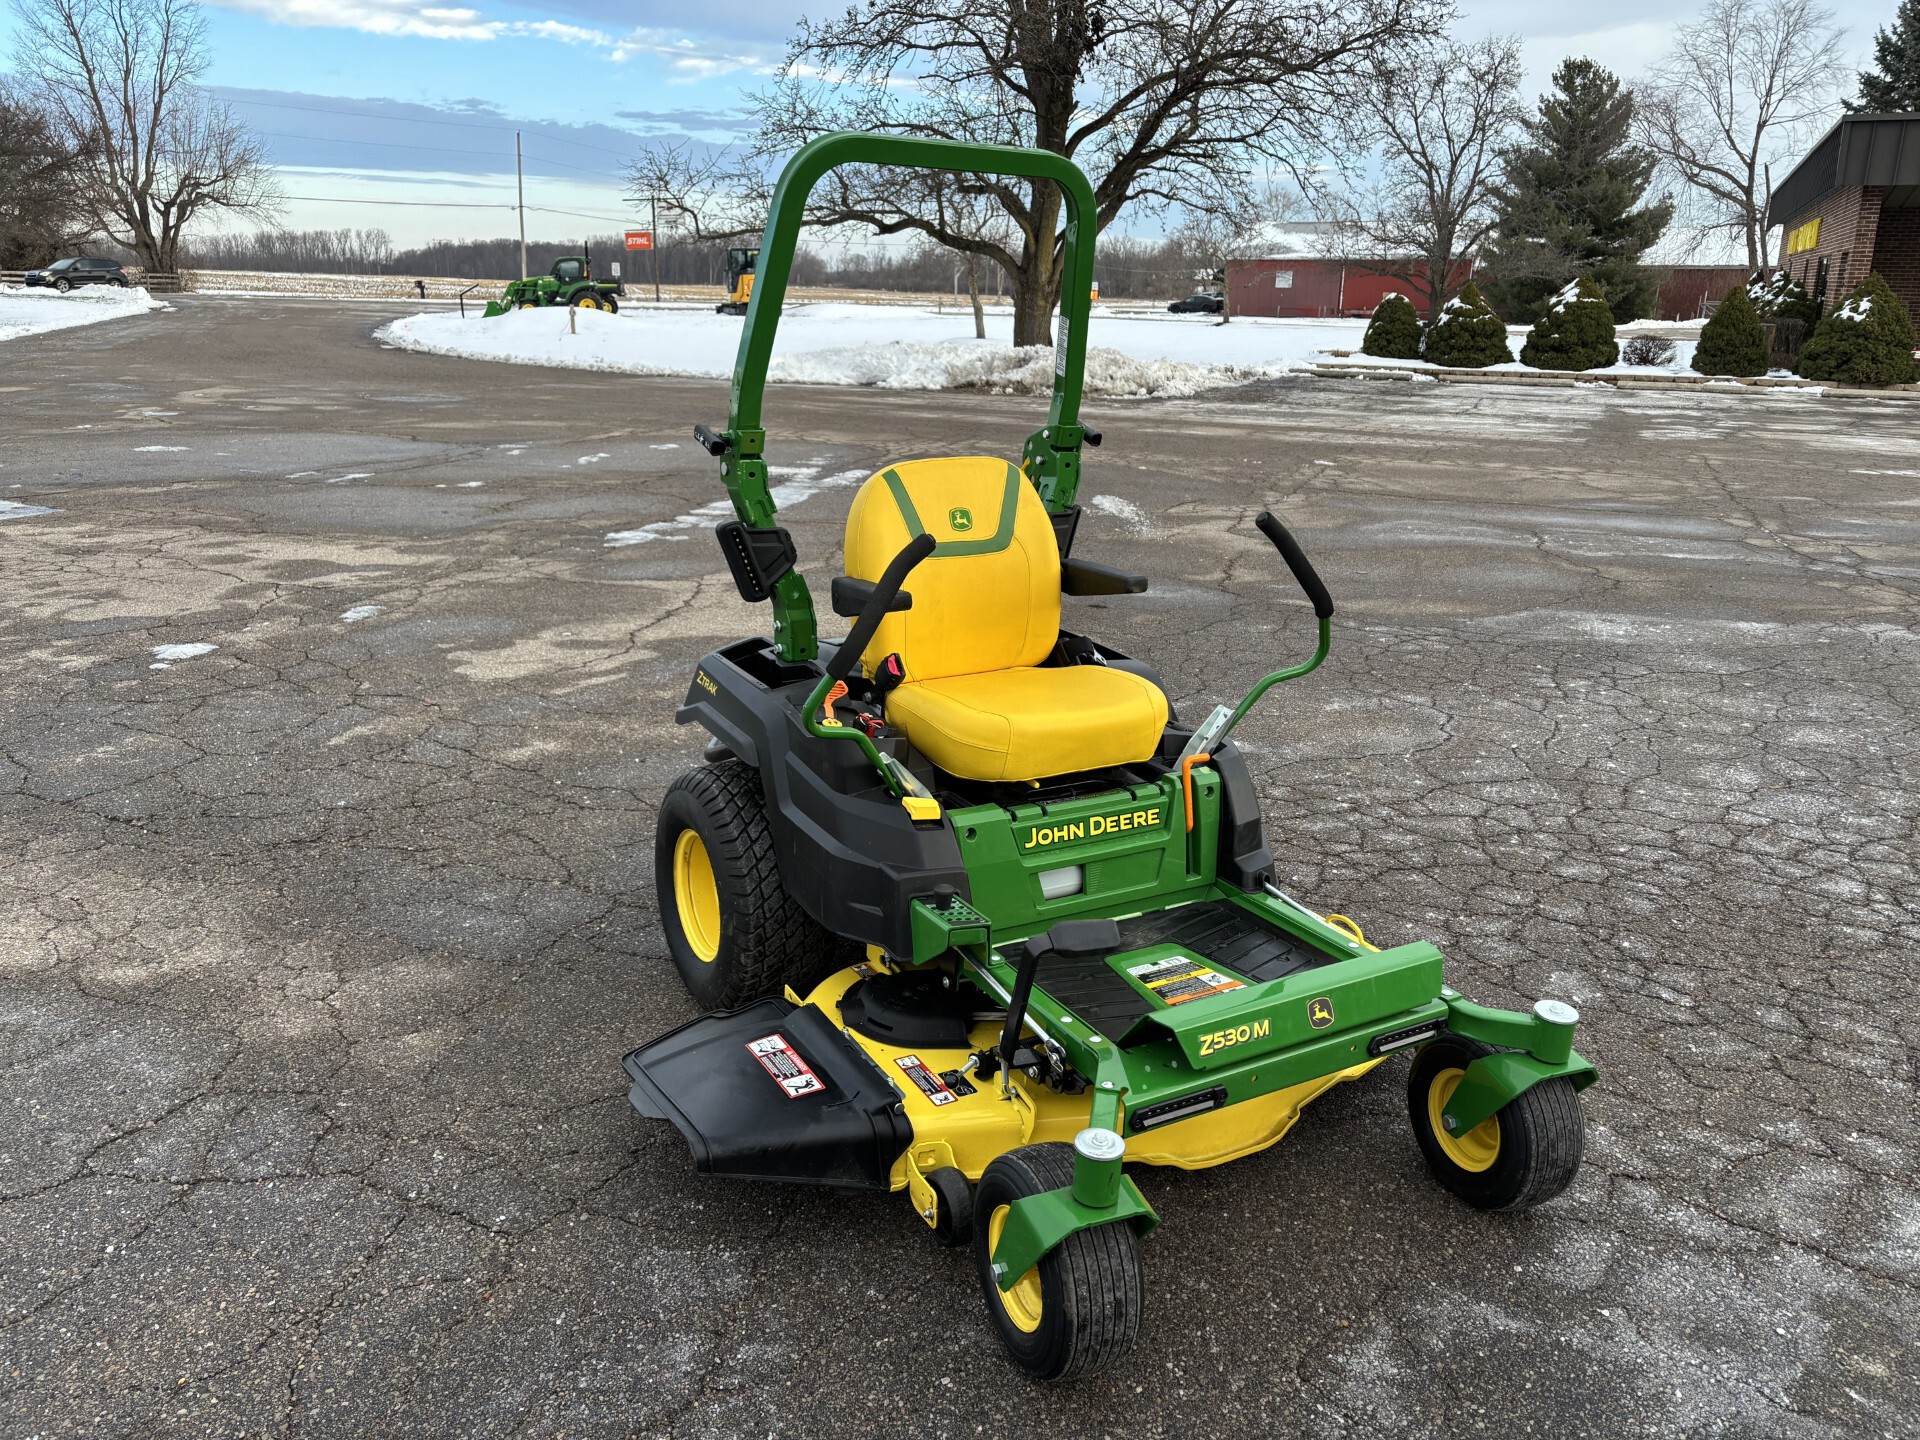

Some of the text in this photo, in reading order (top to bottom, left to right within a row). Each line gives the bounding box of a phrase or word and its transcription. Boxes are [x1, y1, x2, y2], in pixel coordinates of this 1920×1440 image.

[627, 237, 649, 245] STIHL
[697, 671, 718, 696] ZTRAK
[1024, 808, 1161, 849] JOHN DEERE
